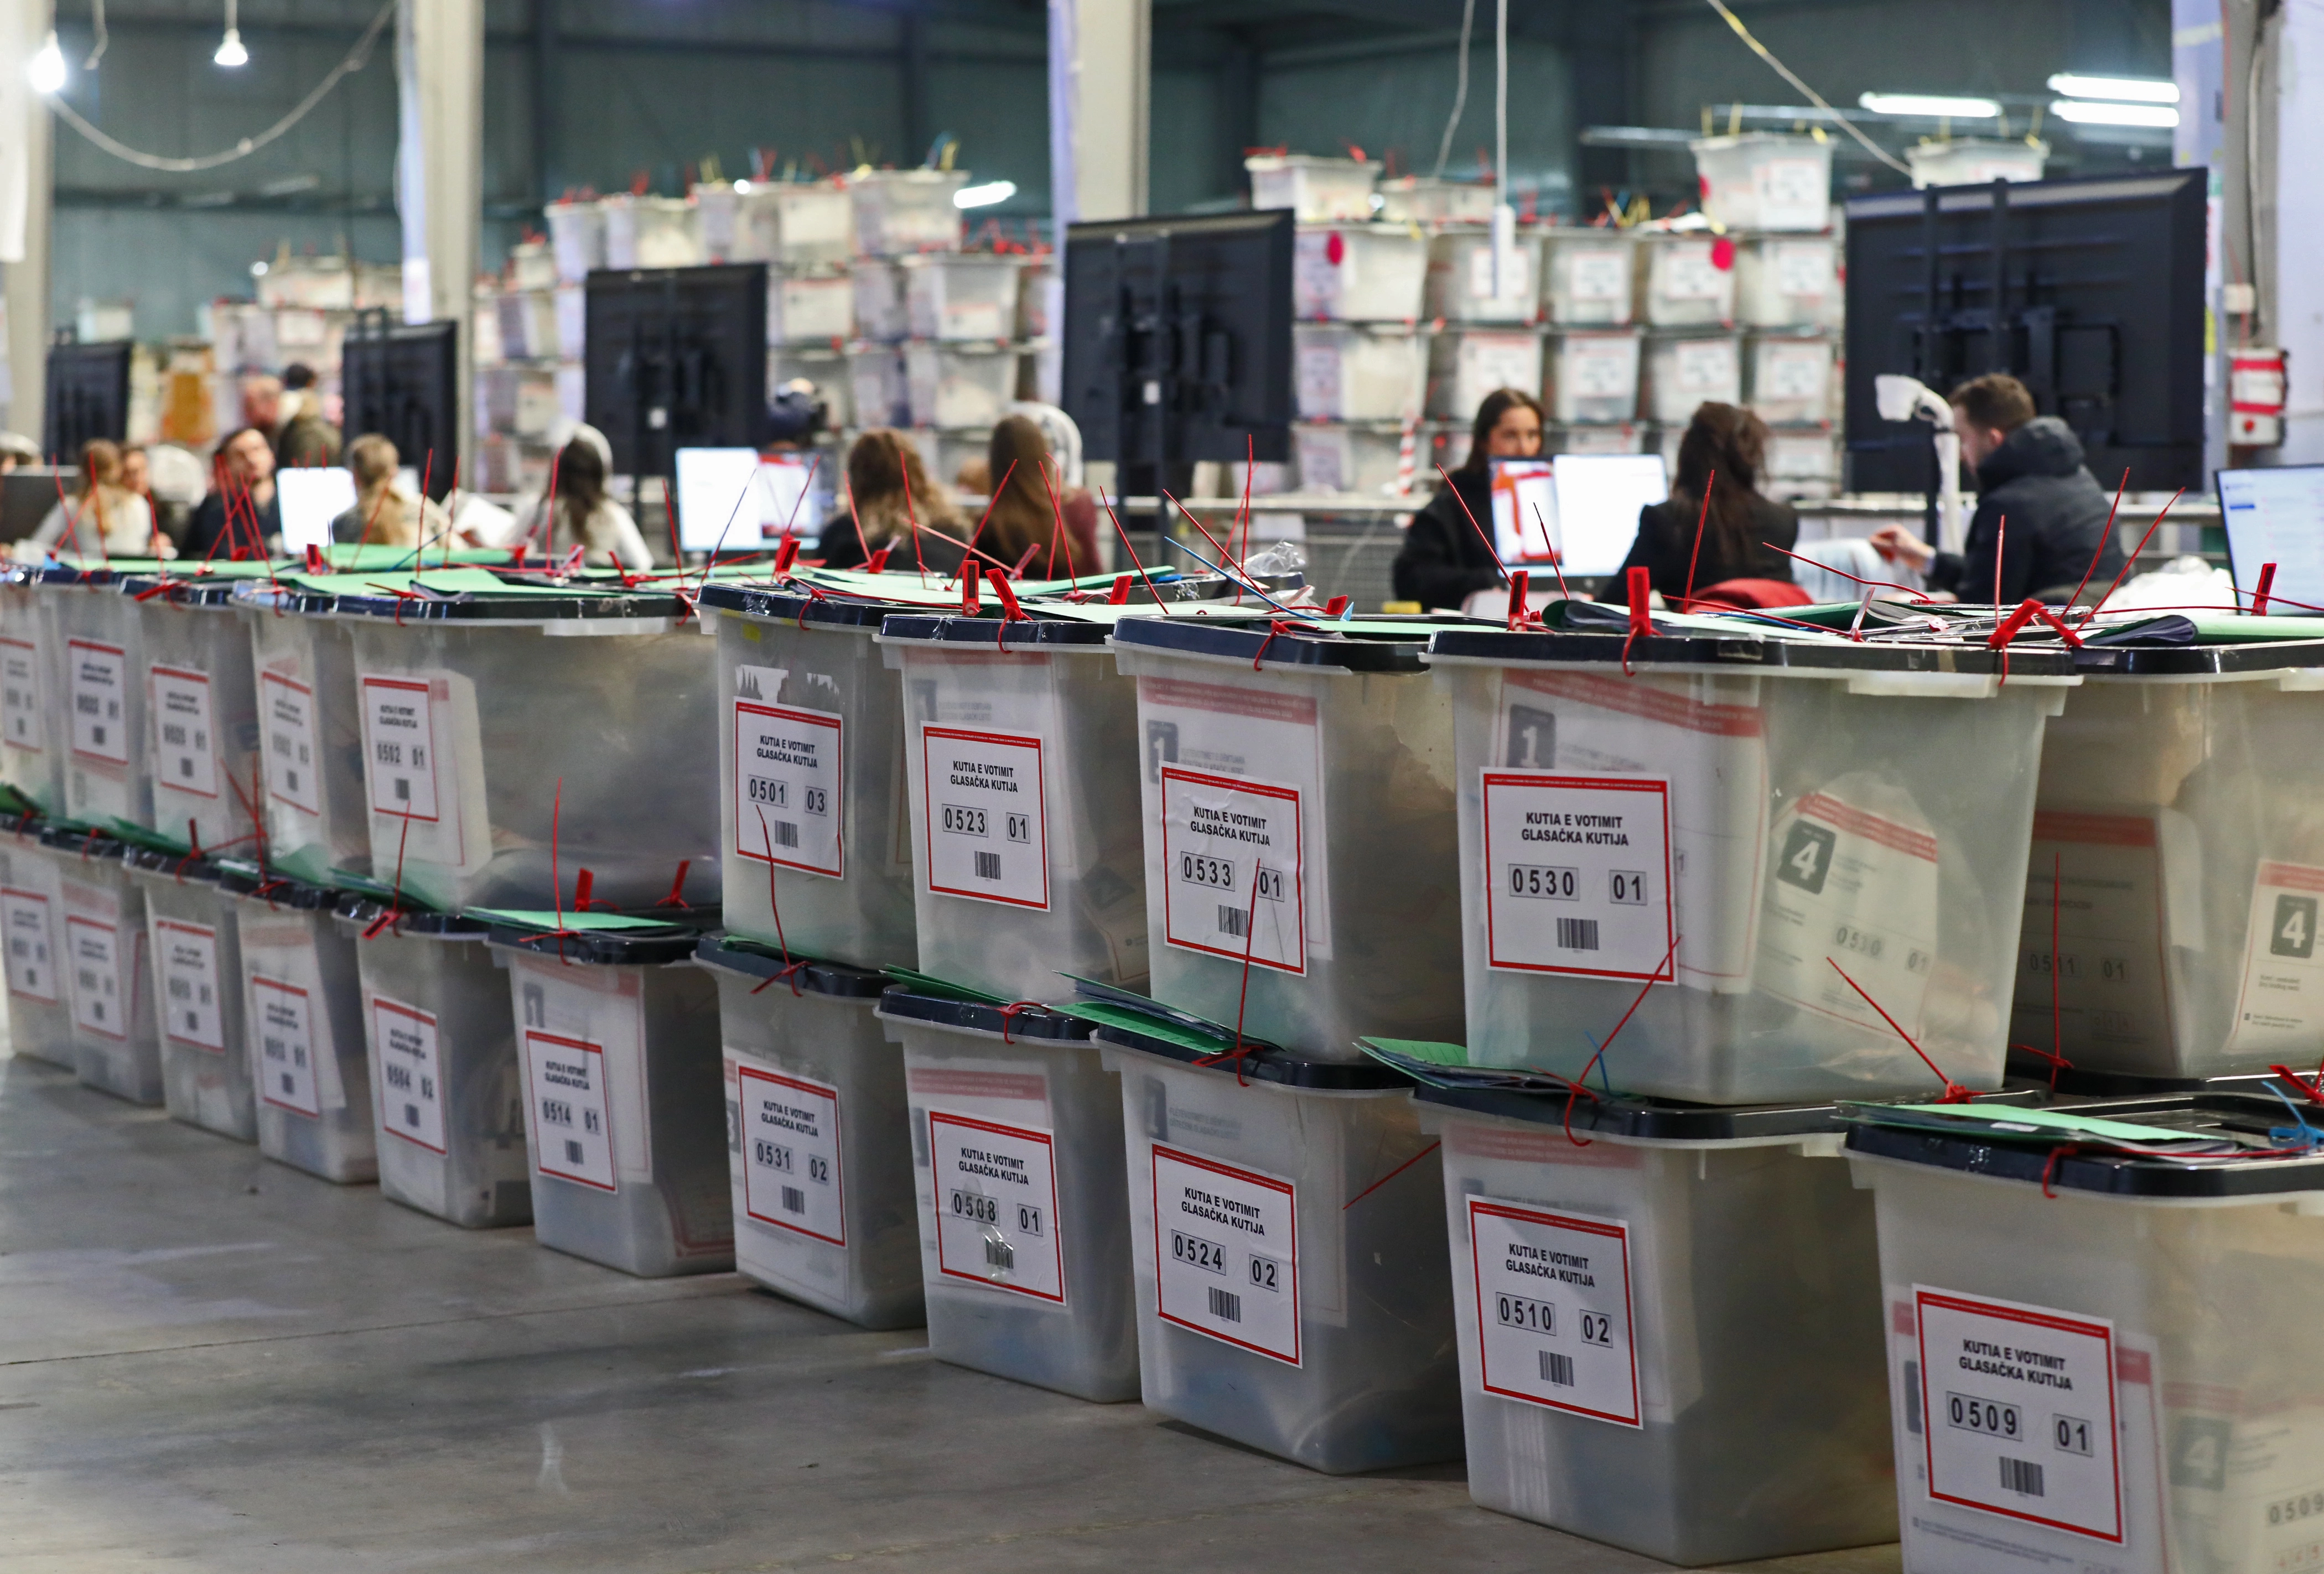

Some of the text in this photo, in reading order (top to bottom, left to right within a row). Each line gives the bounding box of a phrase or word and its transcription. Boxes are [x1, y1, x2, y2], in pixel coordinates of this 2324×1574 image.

[756, 747, 818, 768] GLASAČKA KUTIJA
[760, 735, 816, 755] KUTIA E VOTIMIT
[950, 774, 1018, 793] GLASAČKA KUTIJA
[953, 760, 1014, 778] KUTIA E VOTIMIT
[750, 778, 824, 812] 0501 03
[945, 808, 1026, 839] 0523 01
[1194, 806, 1267, 829] KUTIA E VOTIMIT
[1526, 812, 1622, 828] KUTIA E VOTIMIT
[1190, 820, 1270, 846] GLASAČKA KUTIJA
[1521, 828, 1629, 846] GLASAČKA KUTIJA
[1792, 840, 1820, 880] 4
[1184, 856, 1279, 897] 0533 01
[1513, 869, 1640, 900] 0530 01
[2281, 911, 2306, 948] 4
[2104, 960, 2124, 980] 01
[544, 1102, 597, 1129] 0514 01
[761, 1113, 819, 1137] GLASAČKA KUTIJA
[763, 1100, 815, 1123] KUTIA E VOTIMIT
[757, 1142, 827, 1181] 0531 02
[958, 1160, 1029, 1186] GLASAČKA KUTIJA
[961, 1147, 1024, 1170] KUTIA E VOTIMIT
[954, 1193, 1039, 1232] 0508 01
[1185, 1187, 1260, 1219] KUTIA E VOTIMIT
[1181, 1201, 1265, 1236] GLASAČKA KUTIJA
[1175, 1235, 1275, 1287] 0524 02
[1509, 1243, 1589, 1270] KUTIA E VOTIMIT
[1506, 1259, 1595, 1288] GLASAČKA KUTIJA
[1500, 1297, 1609, 1343] 0510 02
[1963, 1339, 2066, 1370] KUTIA E VOTIMIT
[1959, 1356, 2073, 1391] GLASAČKA KUTIJA
[1952, 1398, 2086, 1450] 0509 01
